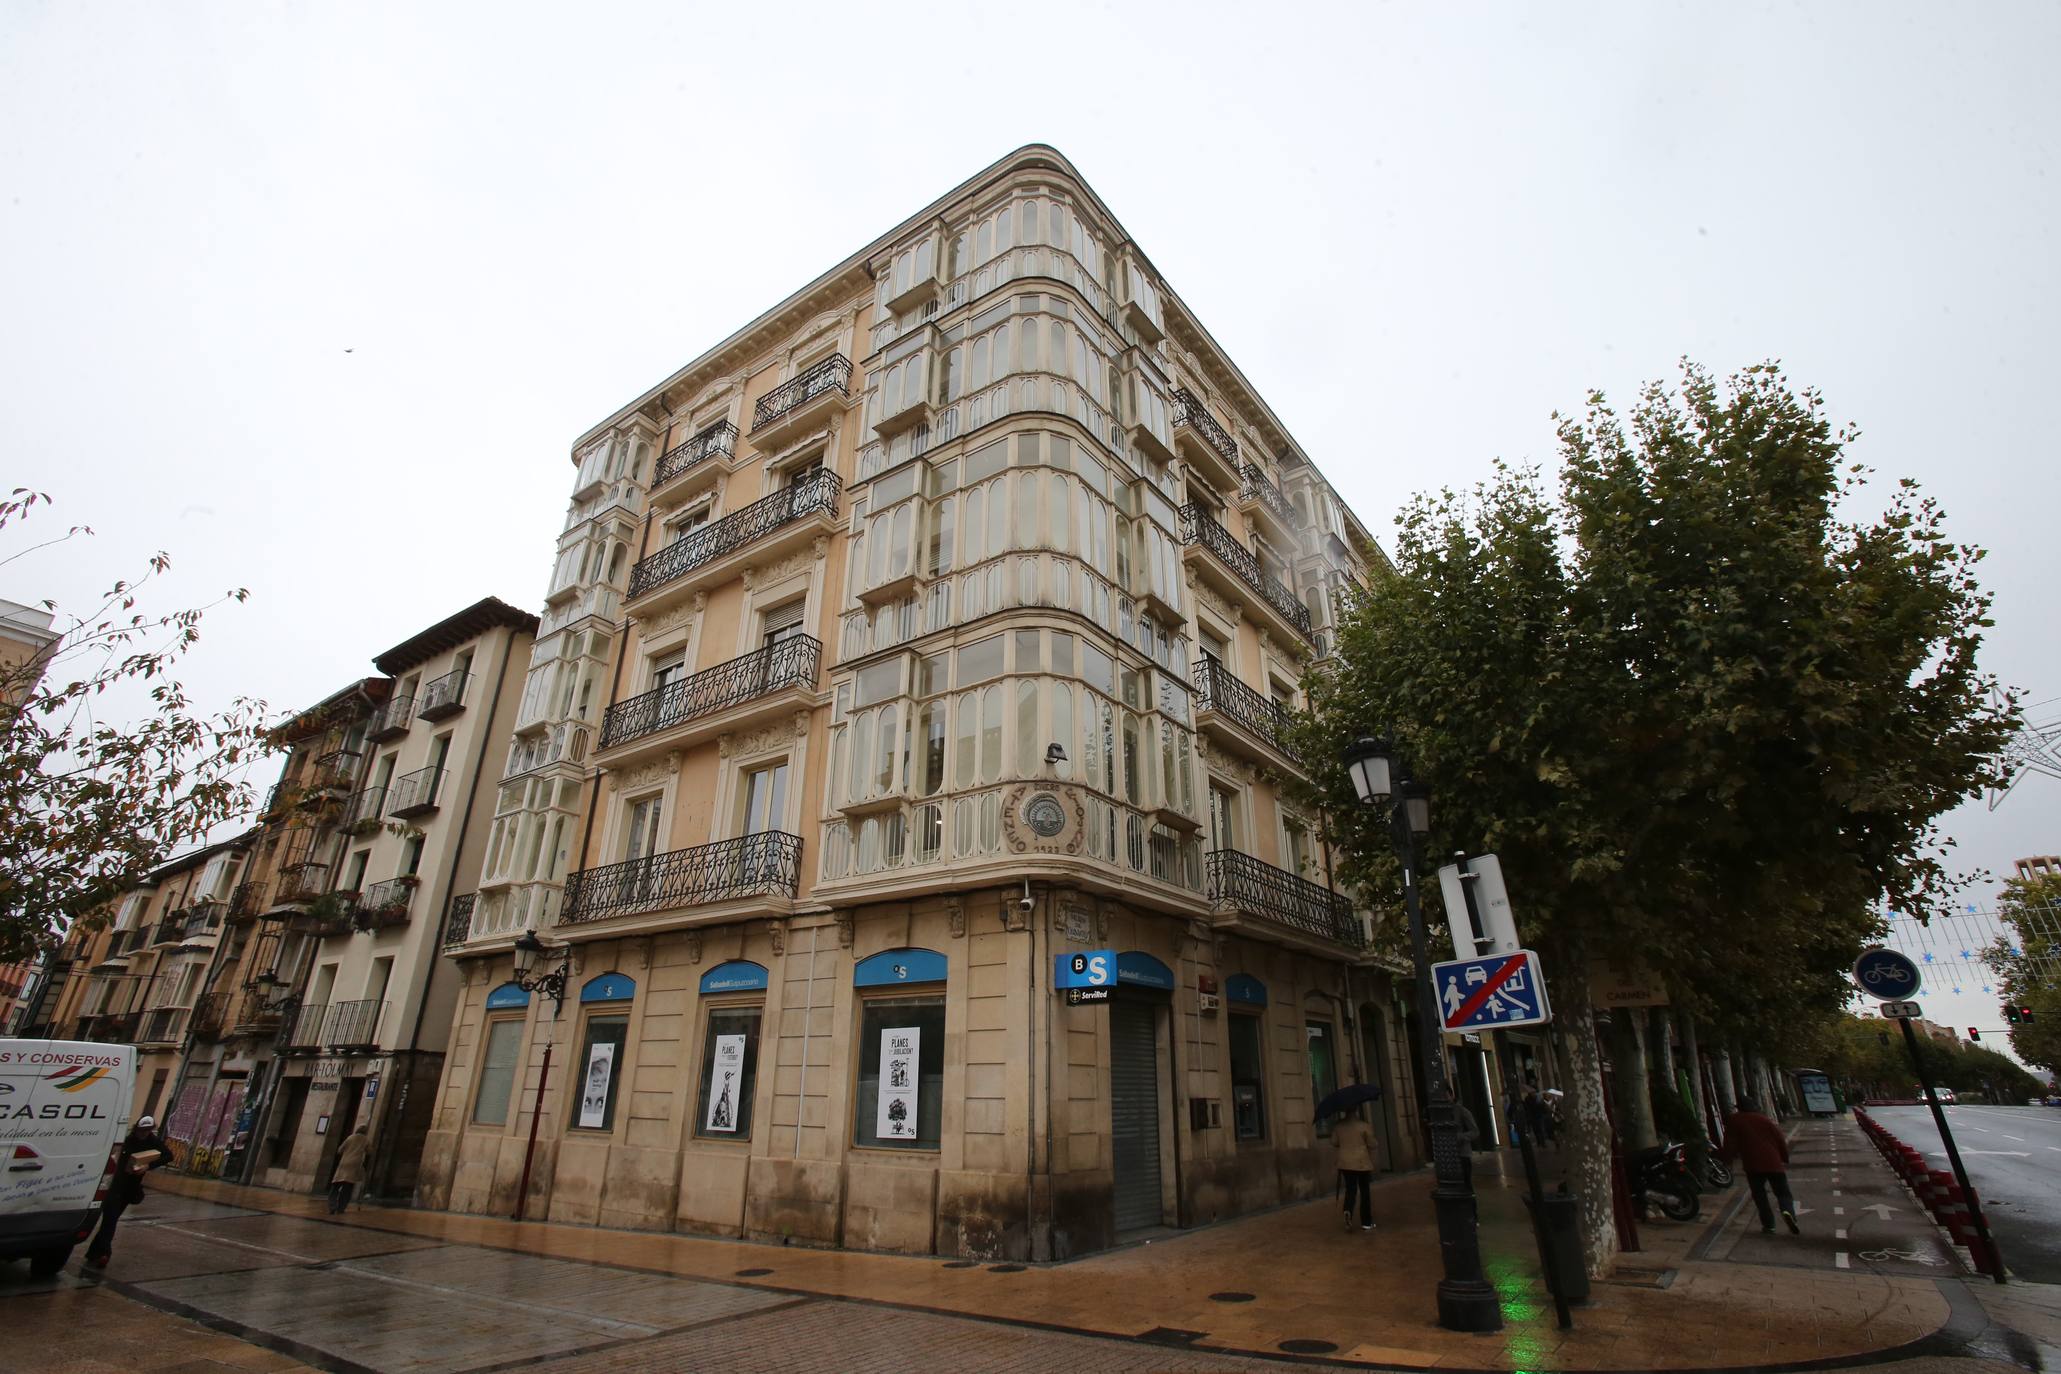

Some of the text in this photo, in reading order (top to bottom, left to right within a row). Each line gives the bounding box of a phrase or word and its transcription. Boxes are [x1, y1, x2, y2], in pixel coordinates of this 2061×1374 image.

[1081, 990, 1108, 999] ServiRed
[891, 1038, 909, 1048] PLANES
[17, 1053, 27, 1063] Y
[30, 1053, 121, 1067] CONSERVAS
[55, 1127, 68, 1137] la
